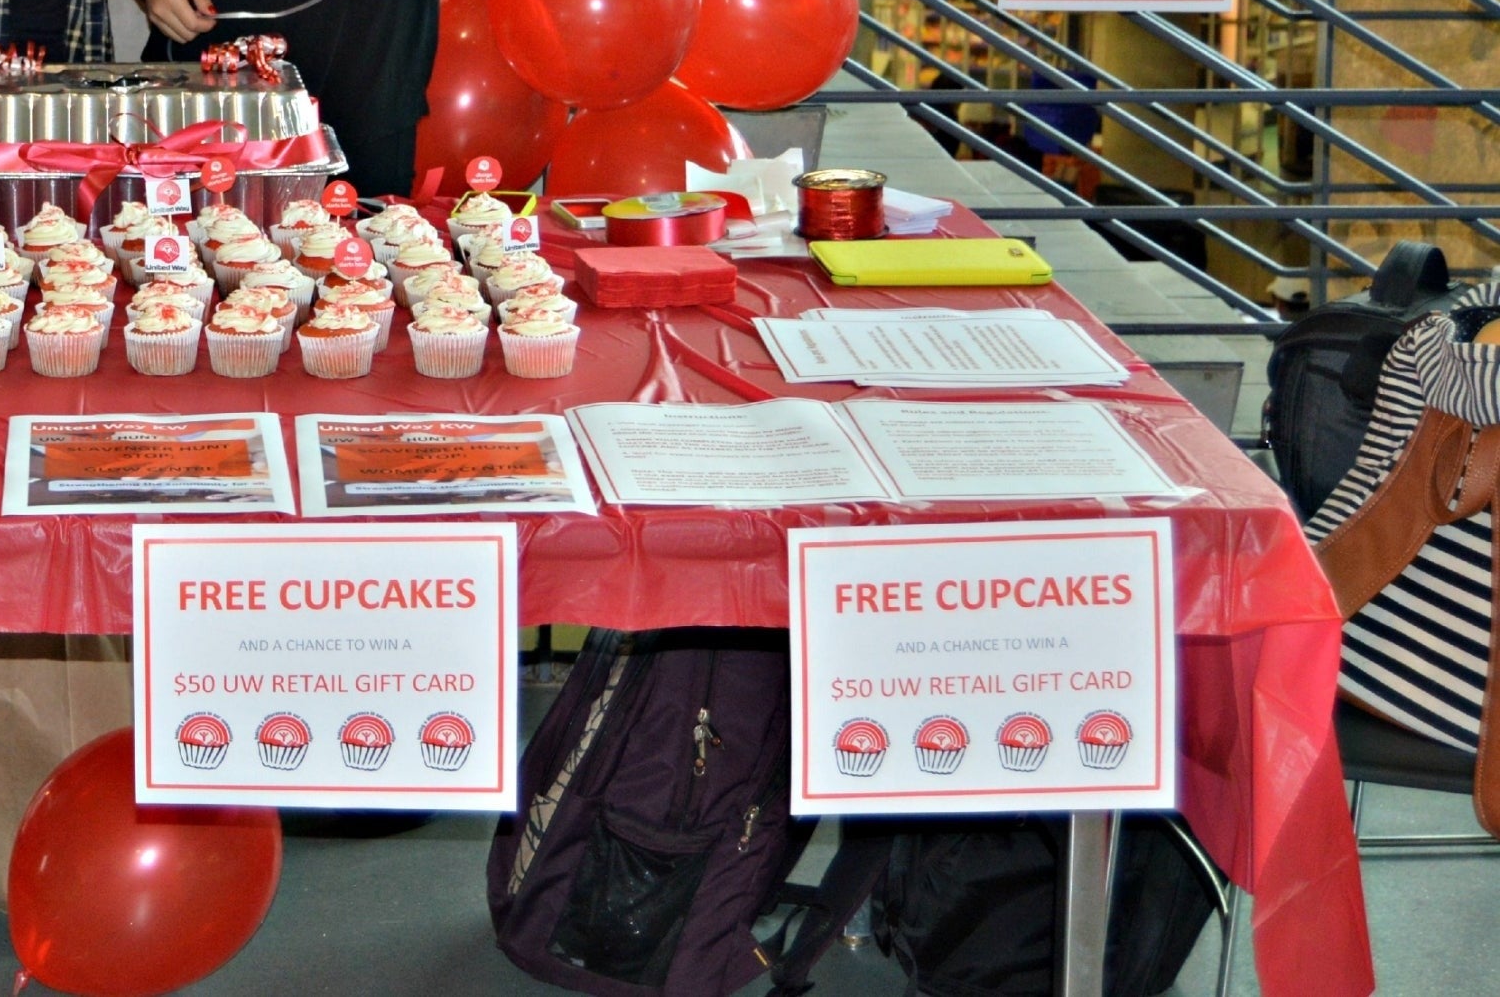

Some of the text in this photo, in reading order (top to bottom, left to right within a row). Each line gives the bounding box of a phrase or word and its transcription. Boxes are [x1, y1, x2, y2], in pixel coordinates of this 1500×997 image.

[31, 423, 188, 432] United Way KW
[318, 423, 385, 433] United
[390, 423, 435, 431] Way
[179, 578, 476, 611] FREE CUPCAKES
[836, 574, 1132, 614] FREE CUPCAKES
[238, 639, 412, 651] AND A CHANCE TO WIN A
[896, 636, 1069, 654] AND A CHANCE TO WIN A
[174, 673, 474, 696] $50 UW RETAIL GIFT CARD
[832, 671, 1132, 701] $50 UW RETAIL GIFT CARD
